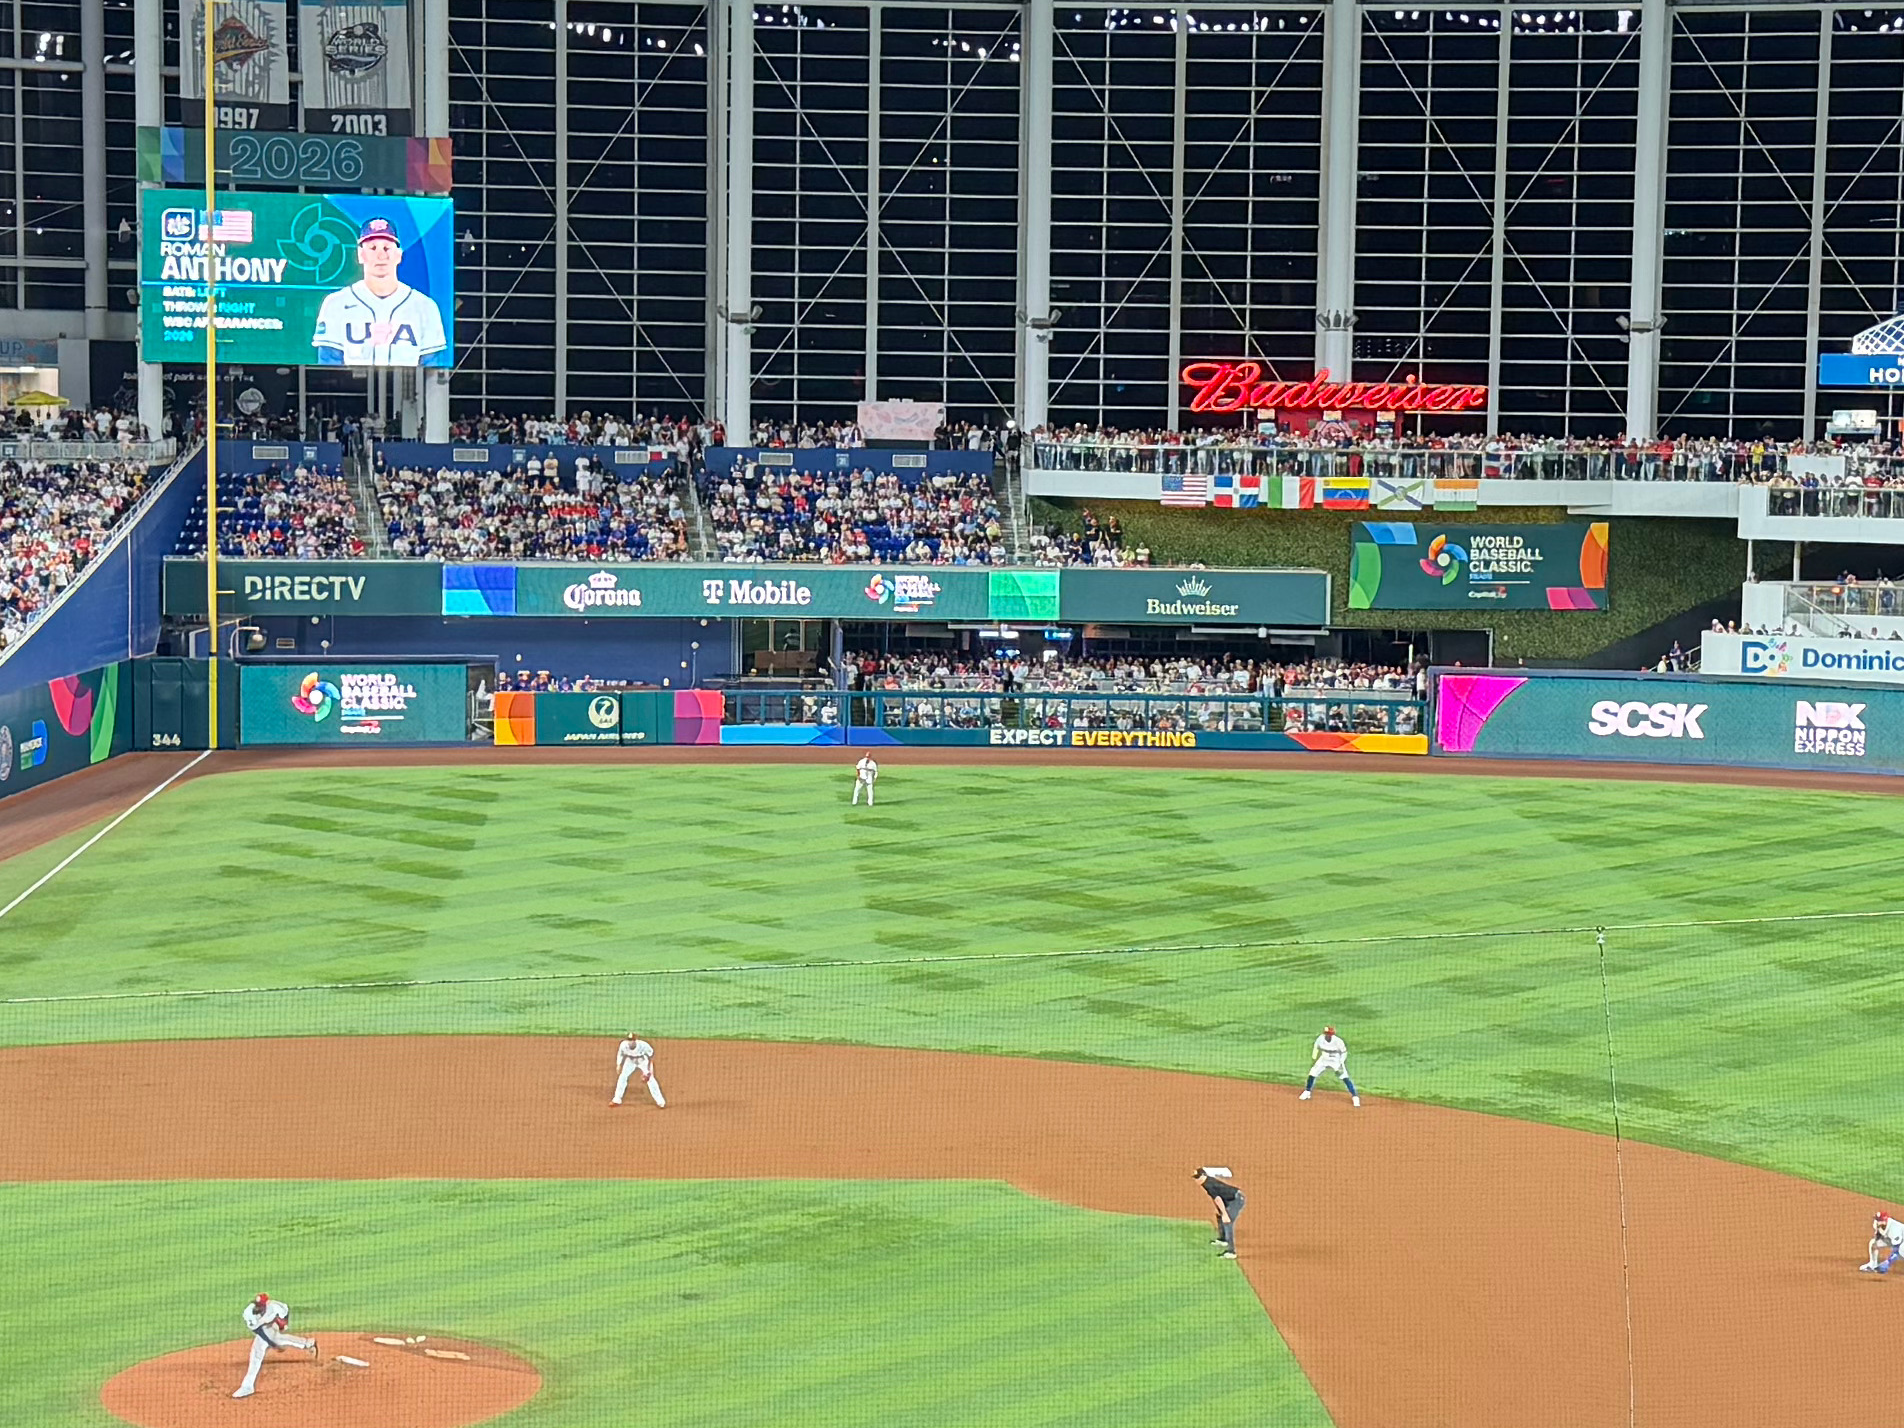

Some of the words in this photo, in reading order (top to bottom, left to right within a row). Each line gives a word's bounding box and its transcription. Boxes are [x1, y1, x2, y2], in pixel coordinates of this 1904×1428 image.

[229, 136, 363, 181] 2026
[1182, 363, 1489, 412] Budweiser
[1470, 536, 1524, 548] WORLD
[1470, 548, 1543, 561] BASEBALL
[245, 575, 366, 601] DIRECTV
[703, 580, 723, 604] T
[729, 580, 812, 604] Mobile
[564, 583, 641, 612] Corona
[1146, 599, 1239, 616] Budweiser
[1588, 700, 1708, 739] SCSK
[152, 732, 181, 747] 344
[990, 729, 1066, 745] EXPECT
[1071, 730, 1196, 747] EVERYTHING
[1795, 727, 1866, 744] NIPPON
[1794, 741, 1866, 756] EXPRESS
